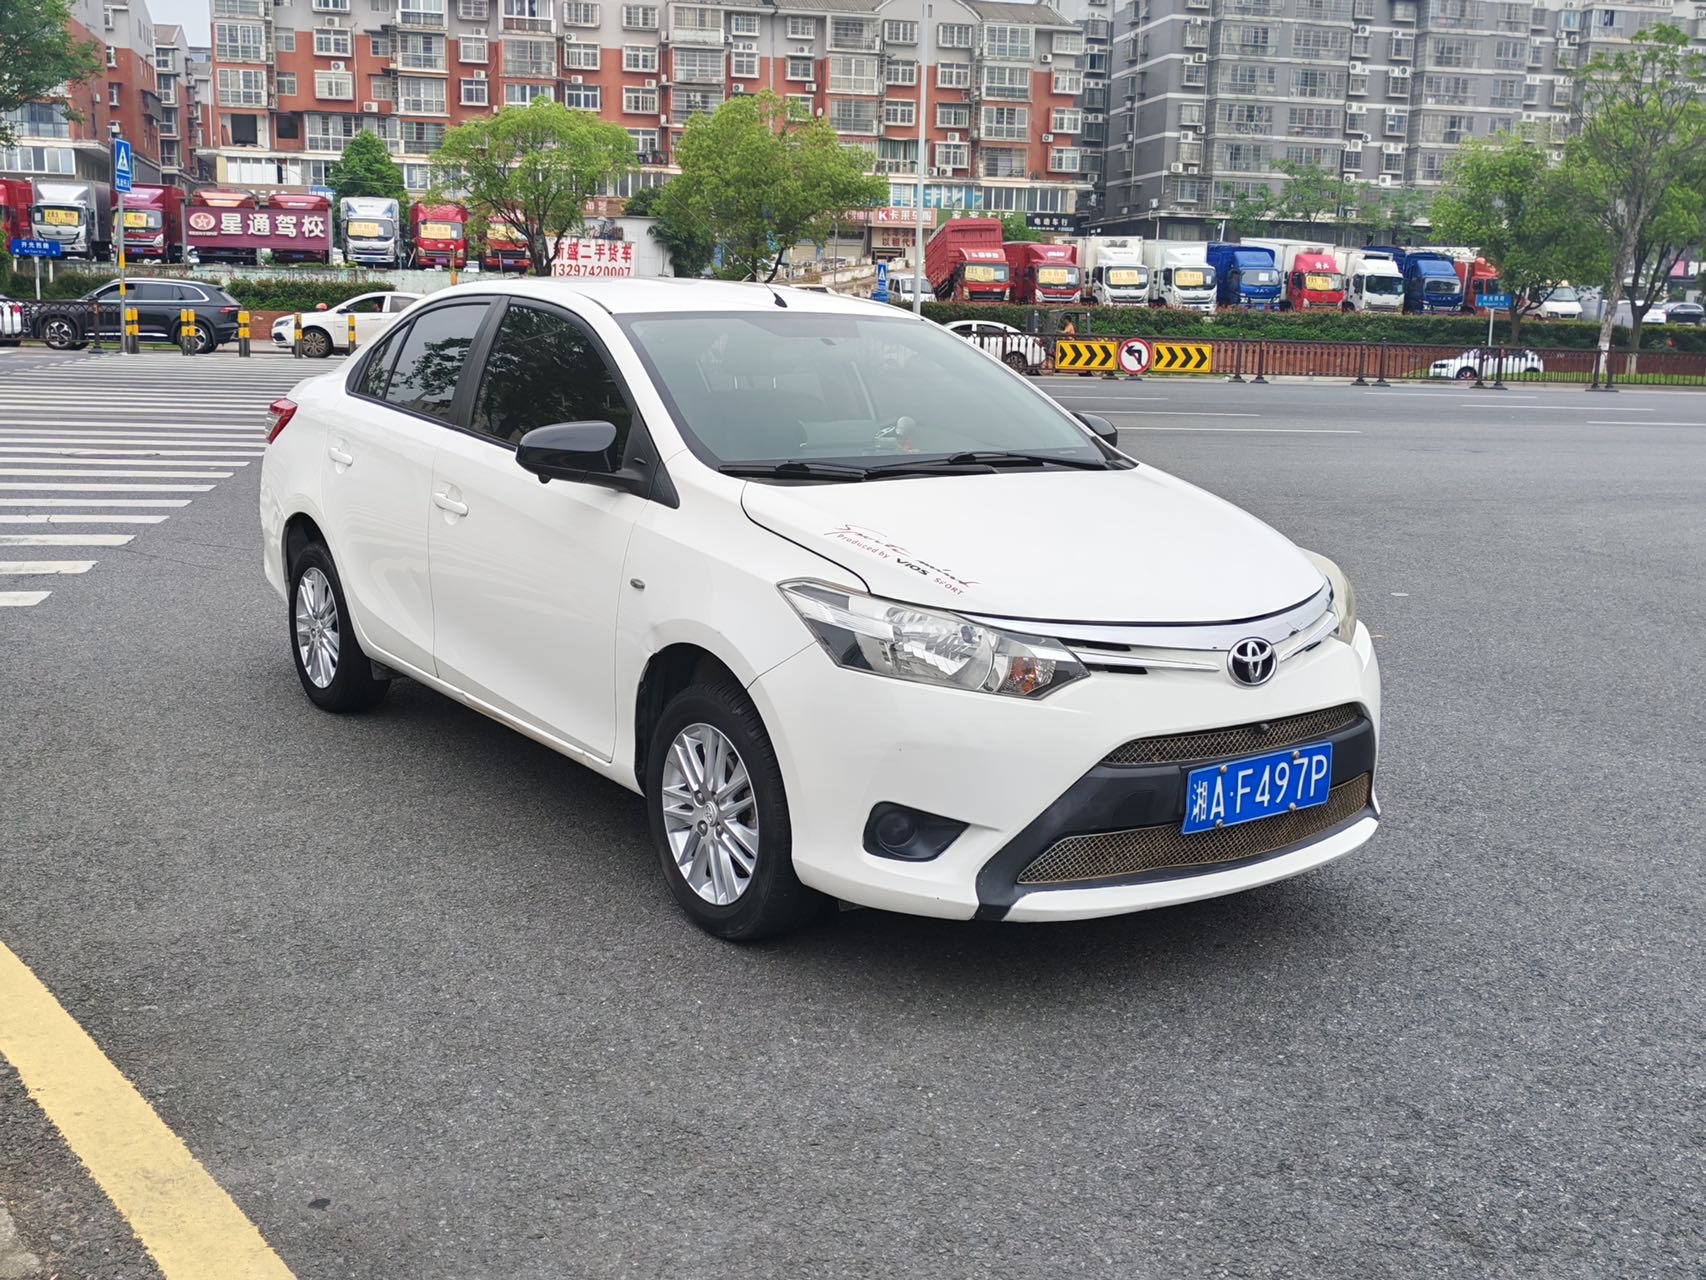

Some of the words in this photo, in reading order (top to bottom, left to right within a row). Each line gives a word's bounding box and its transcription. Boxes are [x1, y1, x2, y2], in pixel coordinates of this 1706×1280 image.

[221, 212, 325, 238] 星通驾校
[552, 263, 631, 276] 13297420007
[836, 533, 880, 553] Produced
[878, 550, 891, 559] by
[896, 557, 930, 576] VIOS
